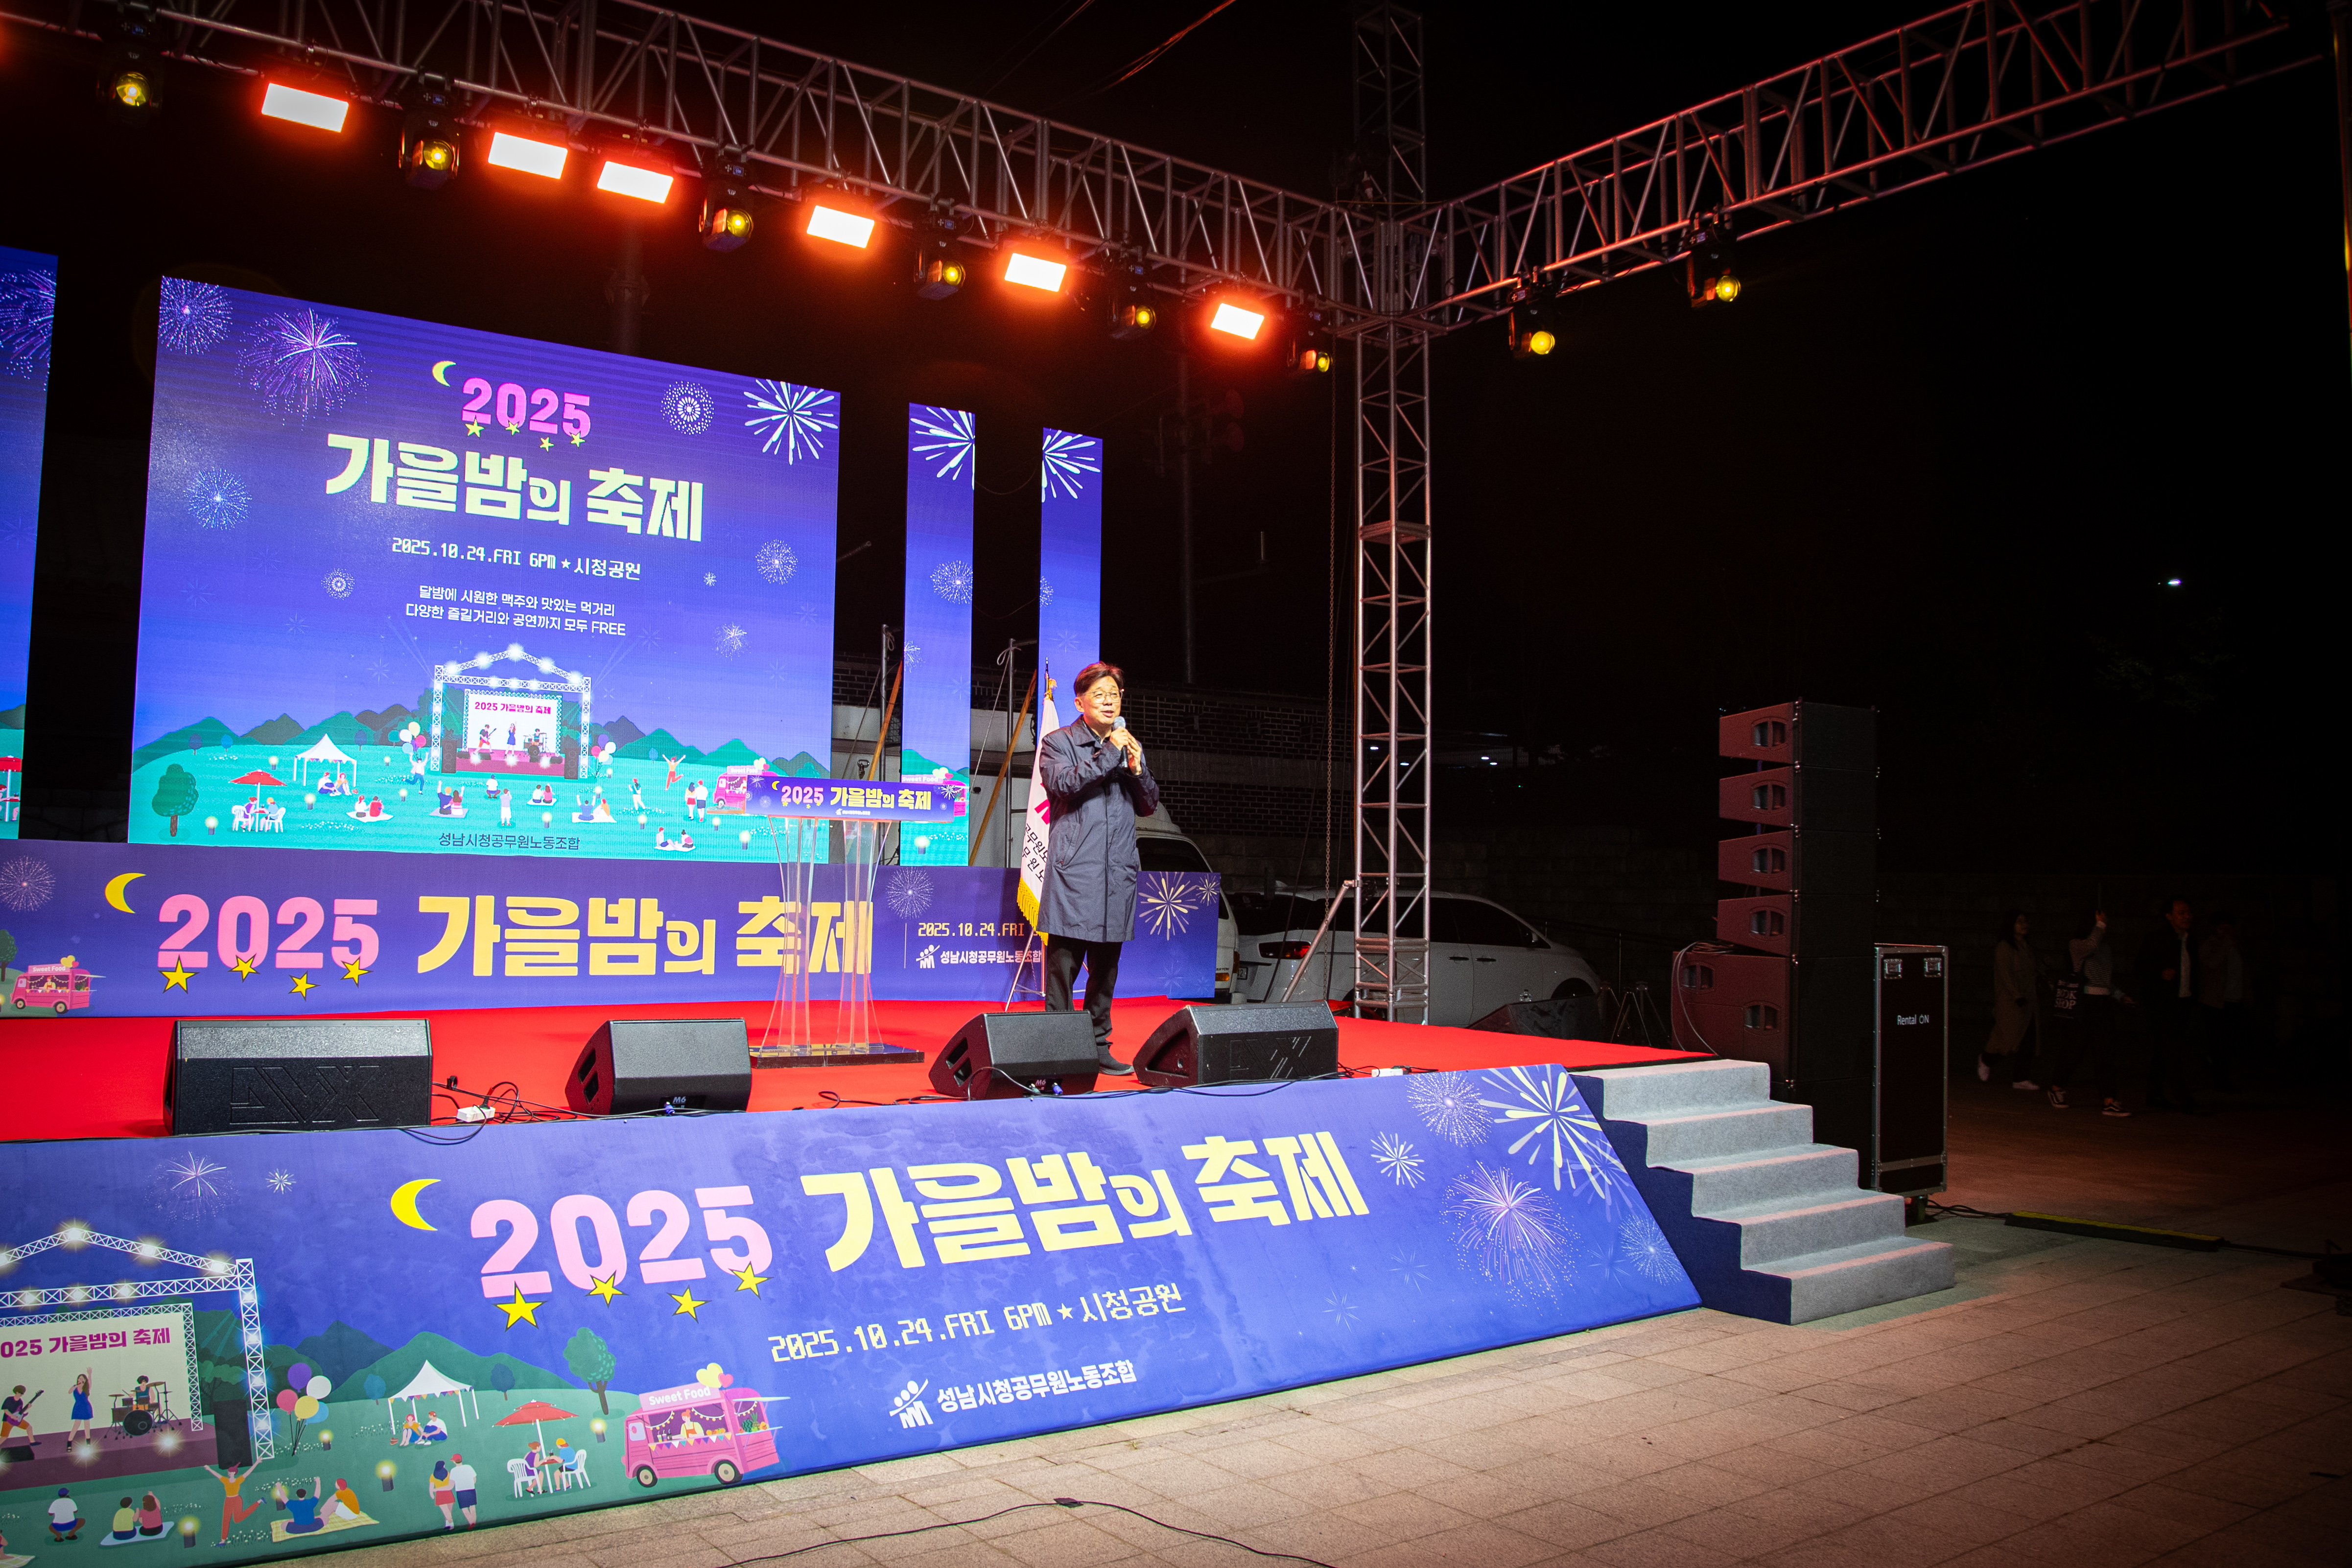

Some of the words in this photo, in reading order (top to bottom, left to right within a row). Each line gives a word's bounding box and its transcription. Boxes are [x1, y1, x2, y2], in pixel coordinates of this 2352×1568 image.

[462, 377, 591, 438] 2025
[326, 434, 571, 526] 가을밤의
[586, 468, 704, 541] 축제
[392, 537, 521, 567] 2025.10.24.FRI
[529, 552, 556, 570] 6PM
[573, 558, 641, 581] 시청공원
[418, 585, 457, 602] 달밤에
[460, 589, 498, 606] 시원한
[501, 593, 539, 610] 맥주와
[541, 596, 576, 613] 맛있는
[580, 599, 615, 617] 먹거리
[405, 603, 444, 620] 다양한
[447, 607, 510, 626] 즐길거리와
[513, 612, 561, 632] 공연까지
[564, 616, 588, 633] 모두
[591, 621, 626, 636] FREE
[475, 702, 498, 711] 2025
[781, 785, 824, 804] 2025
[830, 787, 895, 809] 가을밤의
[898, 789, 932, 811] 축제
[439, 831, 581, 852] 성남시청공무원노동조합
[158, 894, 379, 968] 2025
[417, 895, 716, 977] 가을밤의
[736, 895, 873, 975] 축제
[918, 923, 1024, 936] 2025.10.24.FRI
[940, 950, 1042, 964] 성남시청공무원노동조합
[1897, 1014, 1917, 1025] Rental
[1919, 1014, 1929, 1024] ON
[470, 1185, 773, 1298] 2025
[800, 1151, 1193, 1272] 가을밤의
[1181, 1131, 1369, 1226] 축제
[768, 1309, 995, 1362] 2025.10.24.FRI
[1005, 1302, 1052, 1331] 6PM
[1081, 1282, 1186, 1323] 시청공원
[0, 1339, 43, 1358] 025
[49, 1331, 127, 1353] 가을밤의
[133, 1327, 170, 1345] 축제
[649, 1390, 683, 1405] Sweet
[683, 1385, 711, 1400] Food
[936, 1359, 1138, 1413] 성남시청공무원노동조합
